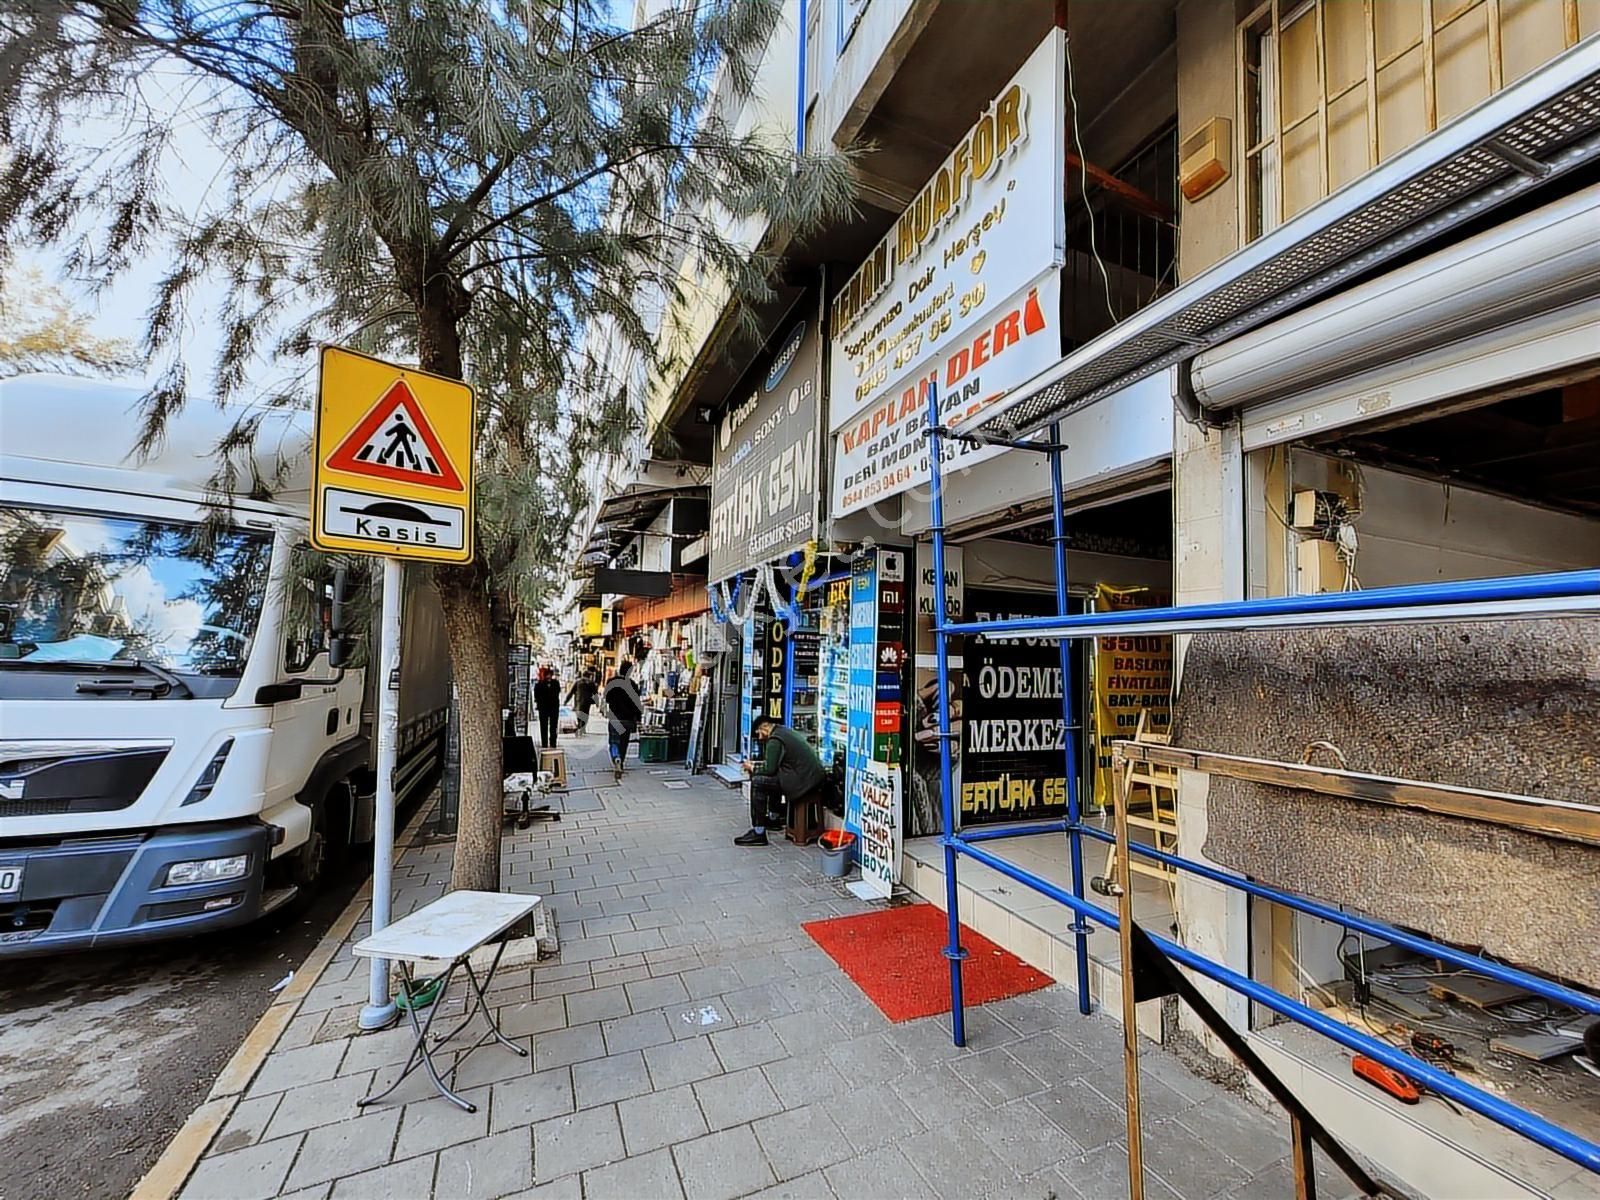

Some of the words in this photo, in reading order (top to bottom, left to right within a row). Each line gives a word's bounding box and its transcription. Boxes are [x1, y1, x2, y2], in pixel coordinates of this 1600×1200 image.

[909, 266, 936, 303] Dair
[844, 369, 937, 455] KAPLAN
[946, 287, 1046, 388] DERİ
[754, 406, 783, 445] SONY
[800, 380, 811, 400] LG
[867, 428, 900, 458] BAY
[769, 429, 814, 517] GSM
[844, 459, 876, 490] DERİ
[356, 517, 437, 543] Kasis
[922, 568, 958, 587] KEAN
[920, 595, 961, 615] KUÖR
[962, 773, 1036, 814] ERTÜRK
[863, 855, 891, 883] BOYA
